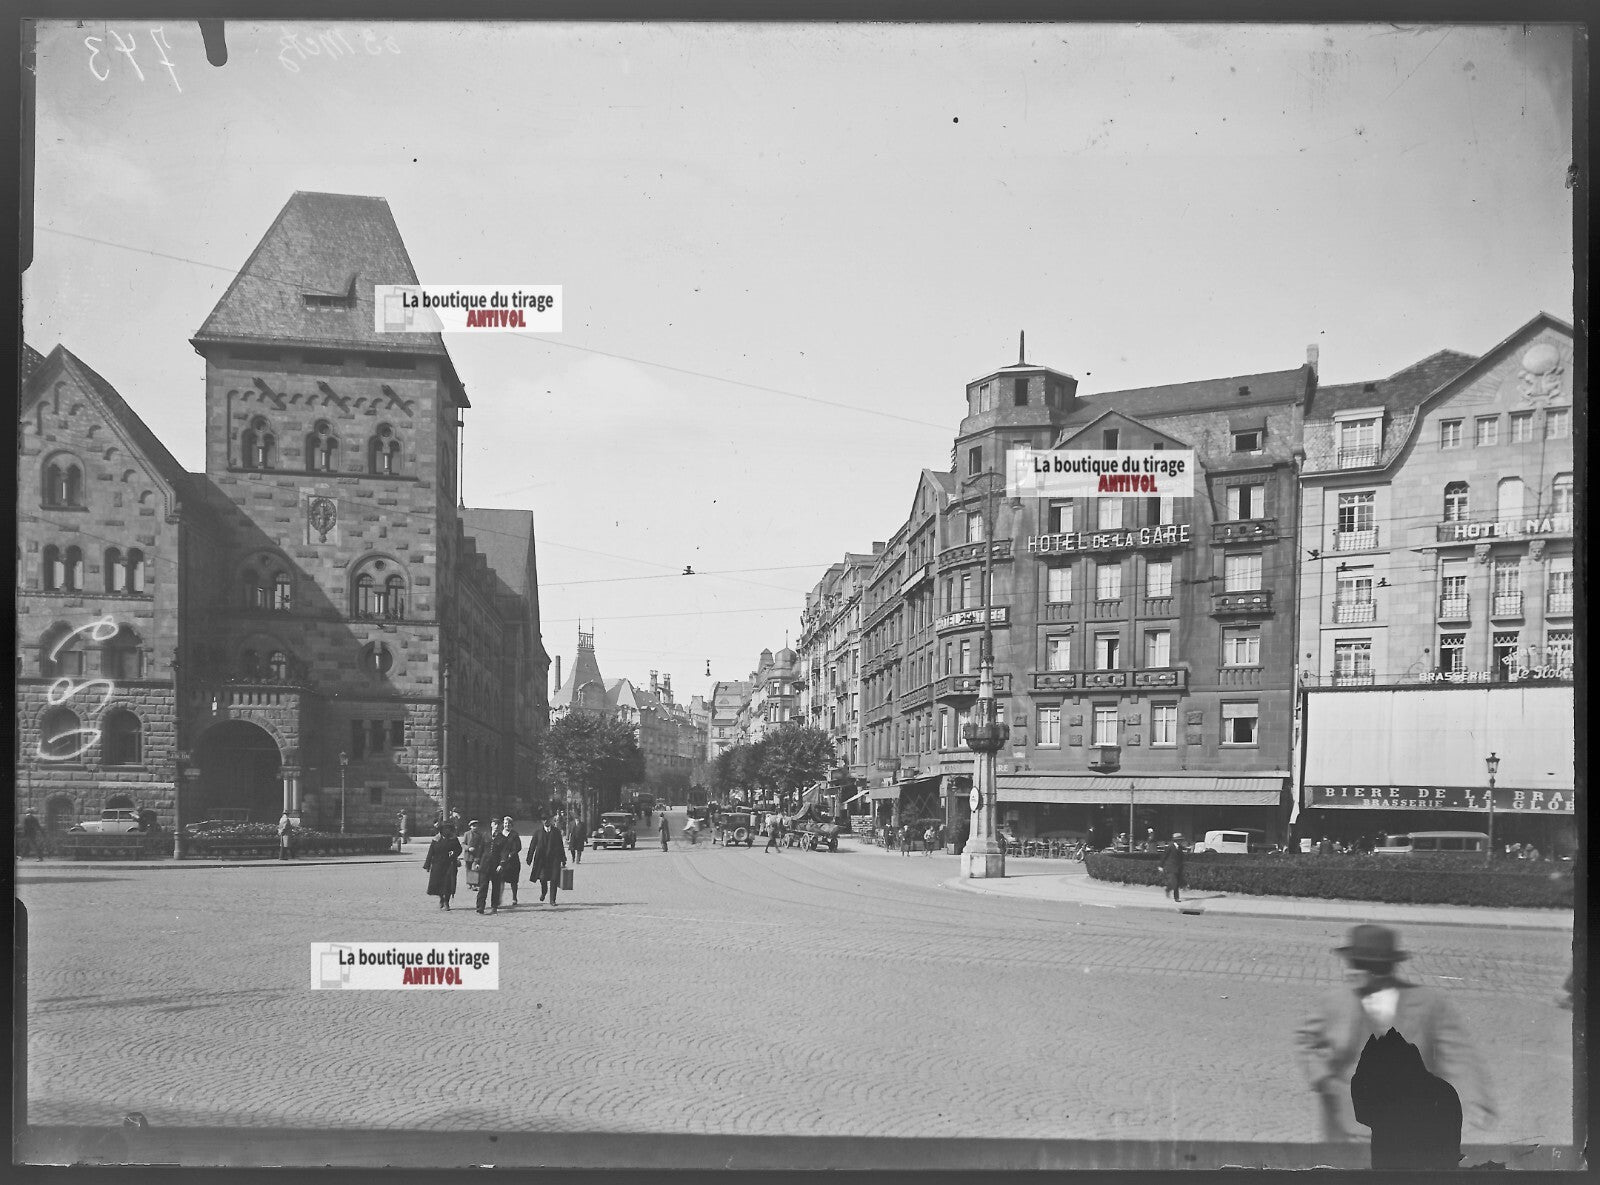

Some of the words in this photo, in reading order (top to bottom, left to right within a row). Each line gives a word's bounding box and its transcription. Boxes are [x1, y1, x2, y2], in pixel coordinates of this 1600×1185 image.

[1454, 520, 1522, 538] HOTEL
[1028, 531, 1088, 553] HOTEL
[1093, 535, 1109, 549] DE
[1115, 533, 1134, 548] LA
[1140, 524, 1191, 546] GARE
[935, 614, 959, 632] HOTEL
[1419, 671, 1491, 682] BRASSERIE
[1325, 788, 1400, 798] BIERE
[1419, 788, 1446, 799] DE
[1465, 789, 1492, 800] LA
[1514, 790, 1574, 802] BRA
[1363, 798, 1443, 808] BRASSERIE
